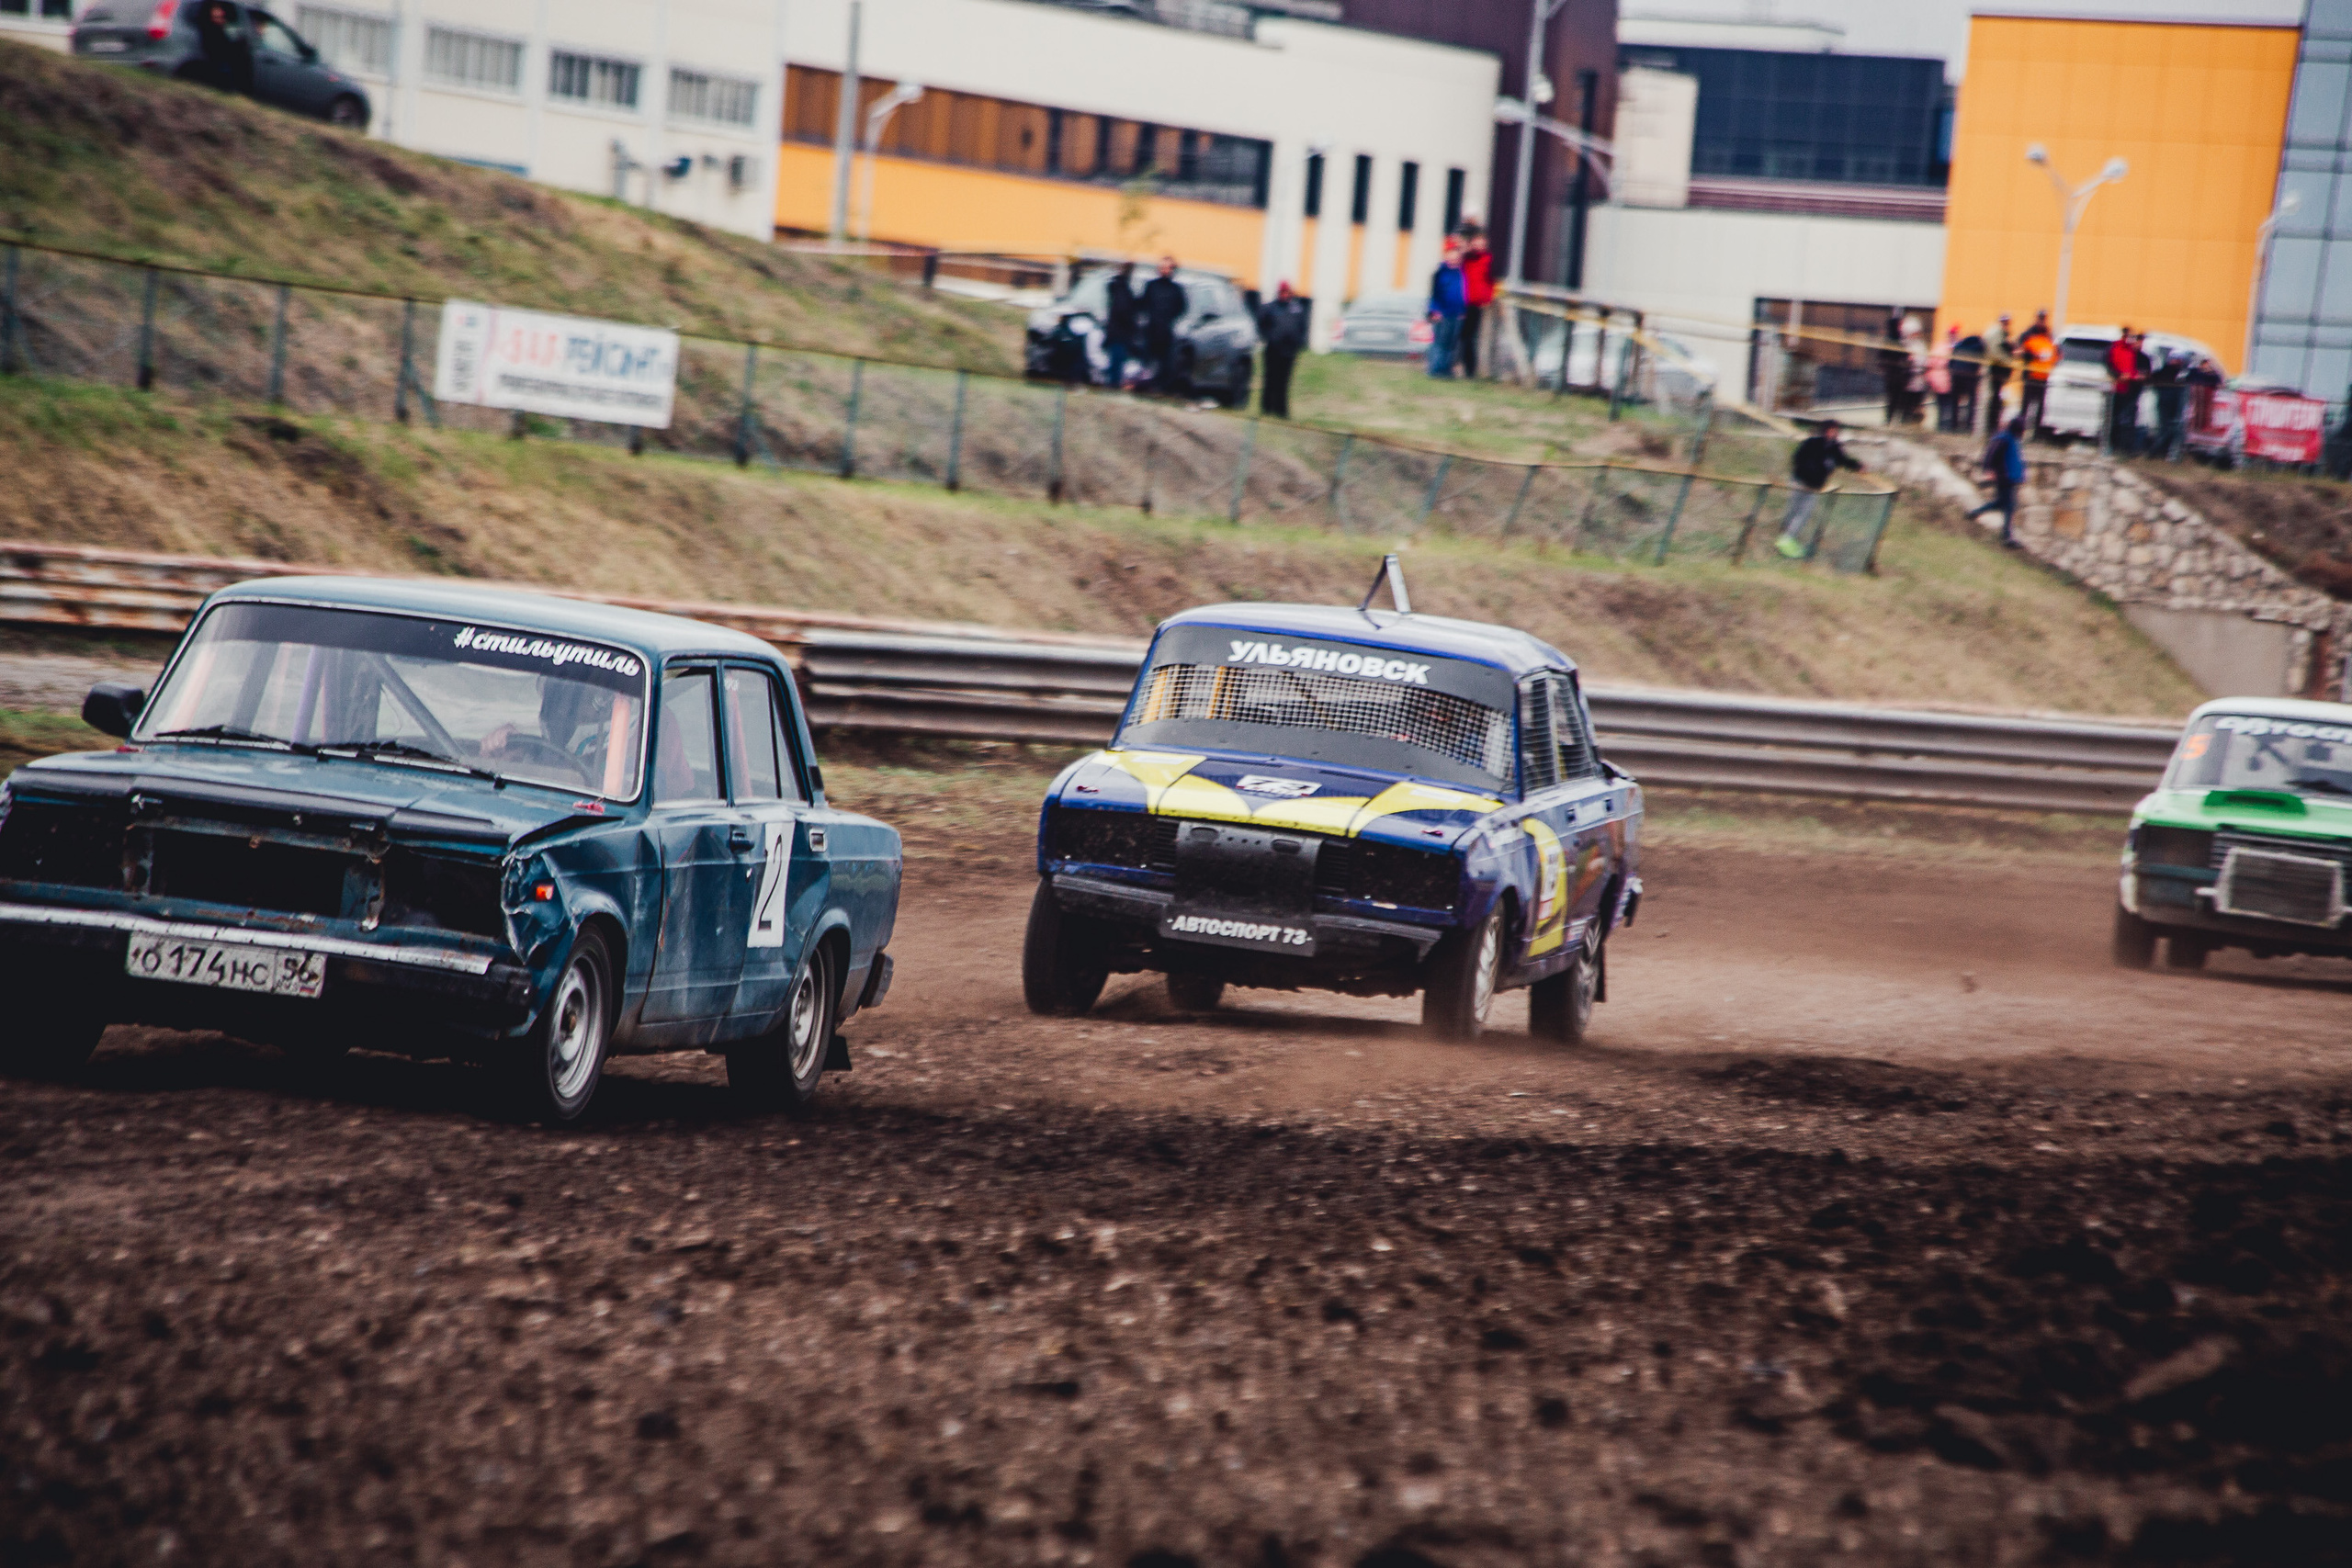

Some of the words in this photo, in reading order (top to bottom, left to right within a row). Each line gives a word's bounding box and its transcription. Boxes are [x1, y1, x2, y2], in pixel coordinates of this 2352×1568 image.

[454, 626, 640, 676] #стильутиль
[1227, 640, 1431, 684] УЛЬЯНОВСК
[757, 834, 783, 931] 2
[1171, 915, 1282, 942] АВТОСПОРТ
[1283, 927, 1308, 945] 73
